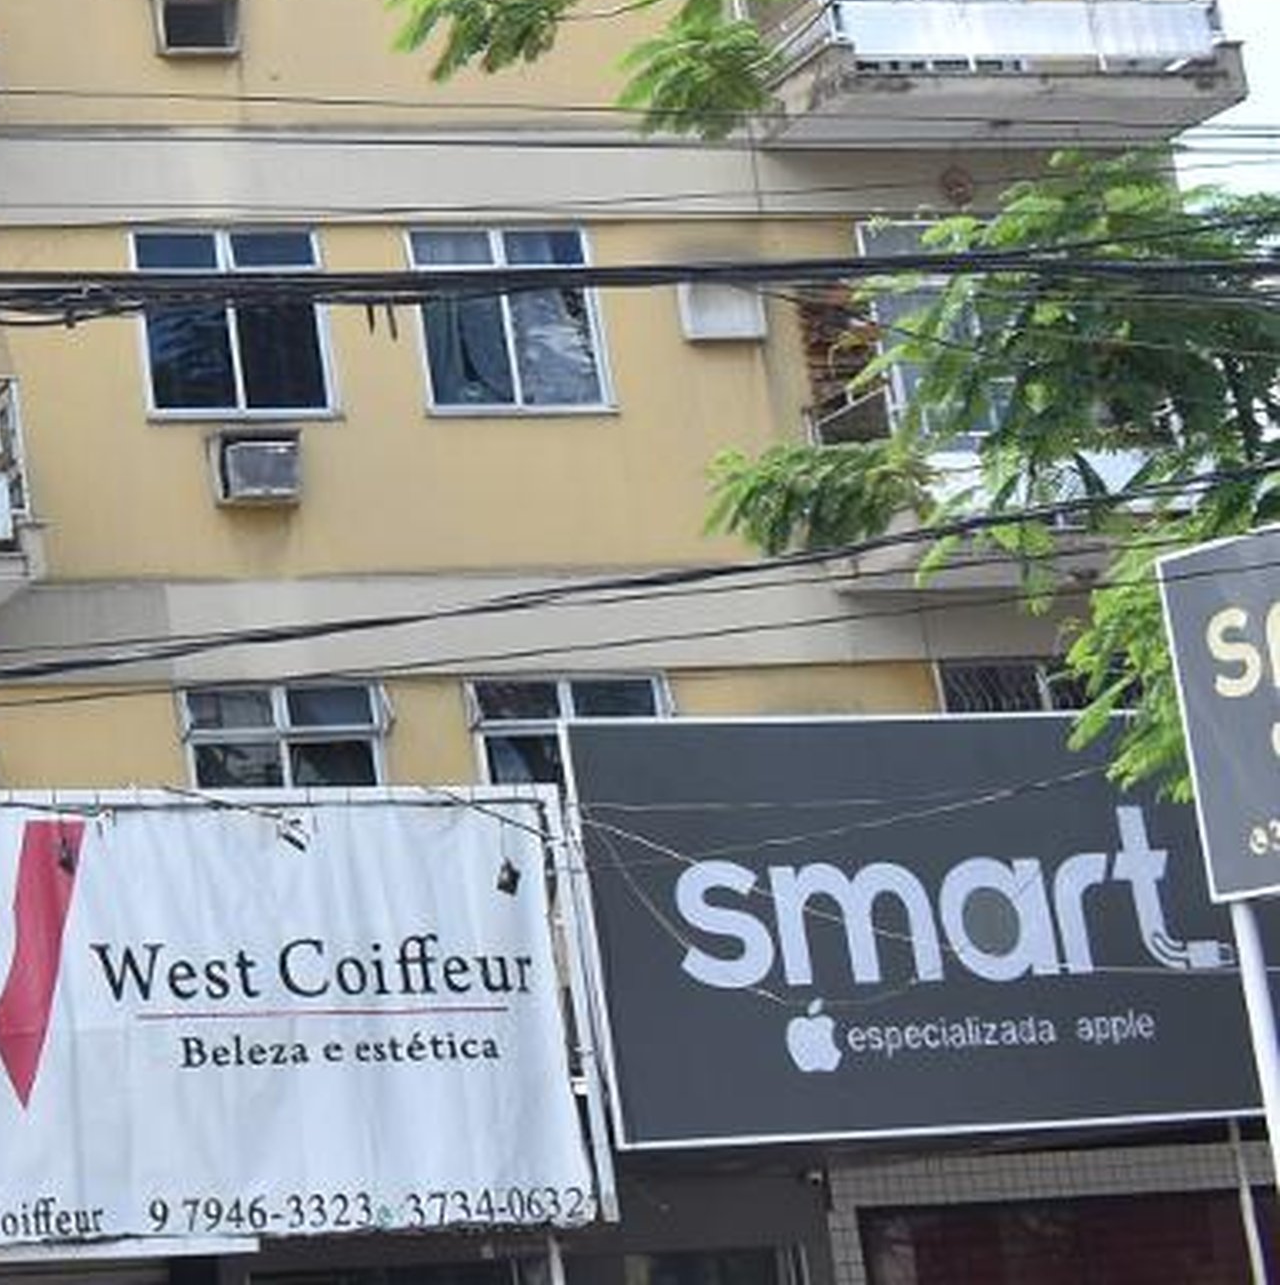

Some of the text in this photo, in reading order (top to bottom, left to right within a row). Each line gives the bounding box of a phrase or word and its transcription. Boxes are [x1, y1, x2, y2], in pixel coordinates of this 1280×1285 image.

[675, 806, 1202, 988] smart
[90, 933, 532, 1002] West Coiffeur
[181, 1030, 500, 1069] Beleza e estética
[847, 1009, 1155, 1057] especializada apple
[148, 1199, 170, 1231] 9
[183, 1191, 372, 1231] 7946-3323
[407, 1186, 586, 1226] 3734-0632
